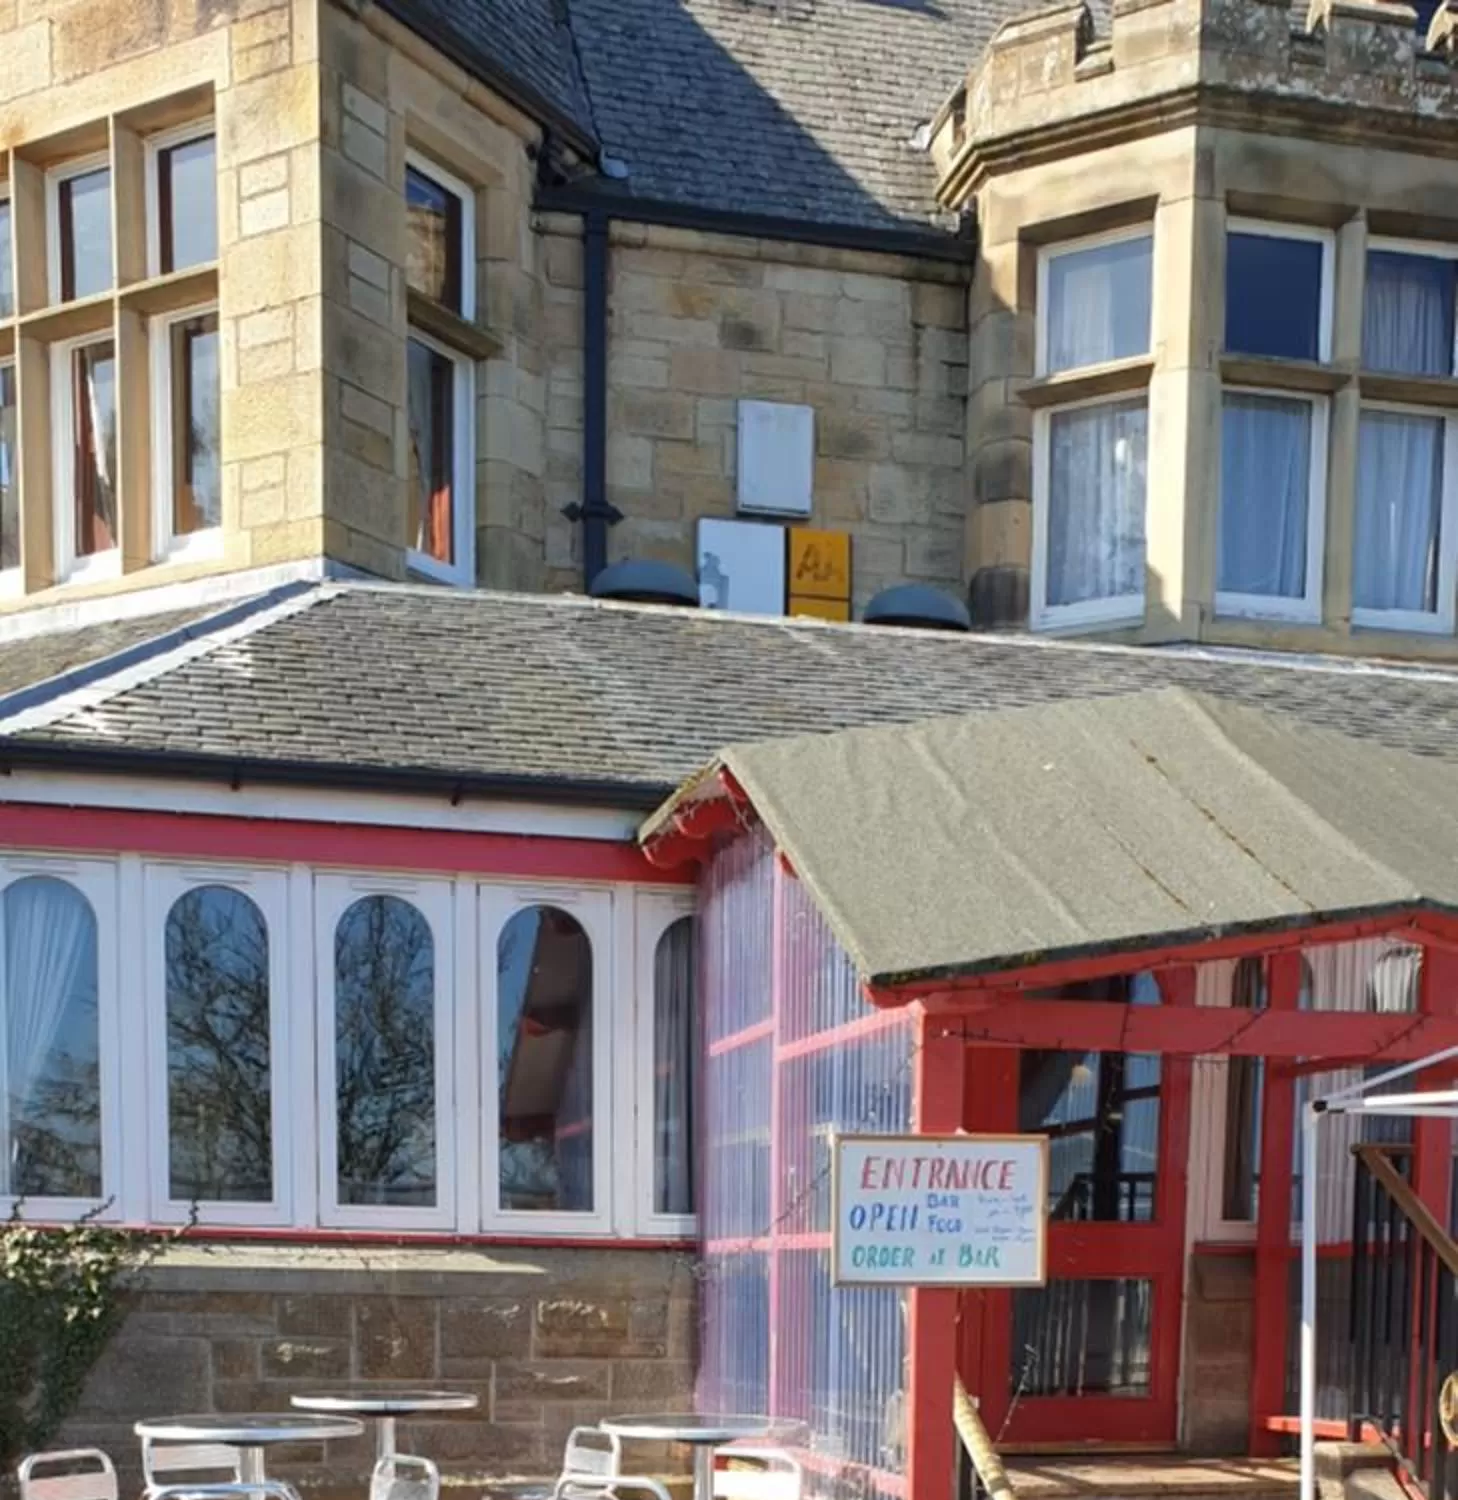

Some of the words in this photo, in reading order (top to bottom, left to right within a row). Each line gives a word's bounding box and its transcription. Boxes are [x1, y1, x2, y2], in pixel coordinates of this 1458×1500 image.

[861, 1155, 1017, 1190] ENTRANCE
[849, 1202, 919, 1232] OPEN
[852, 1243, 915, 1269] ORDER
[958, 1243, 1001, 1269] BAR
